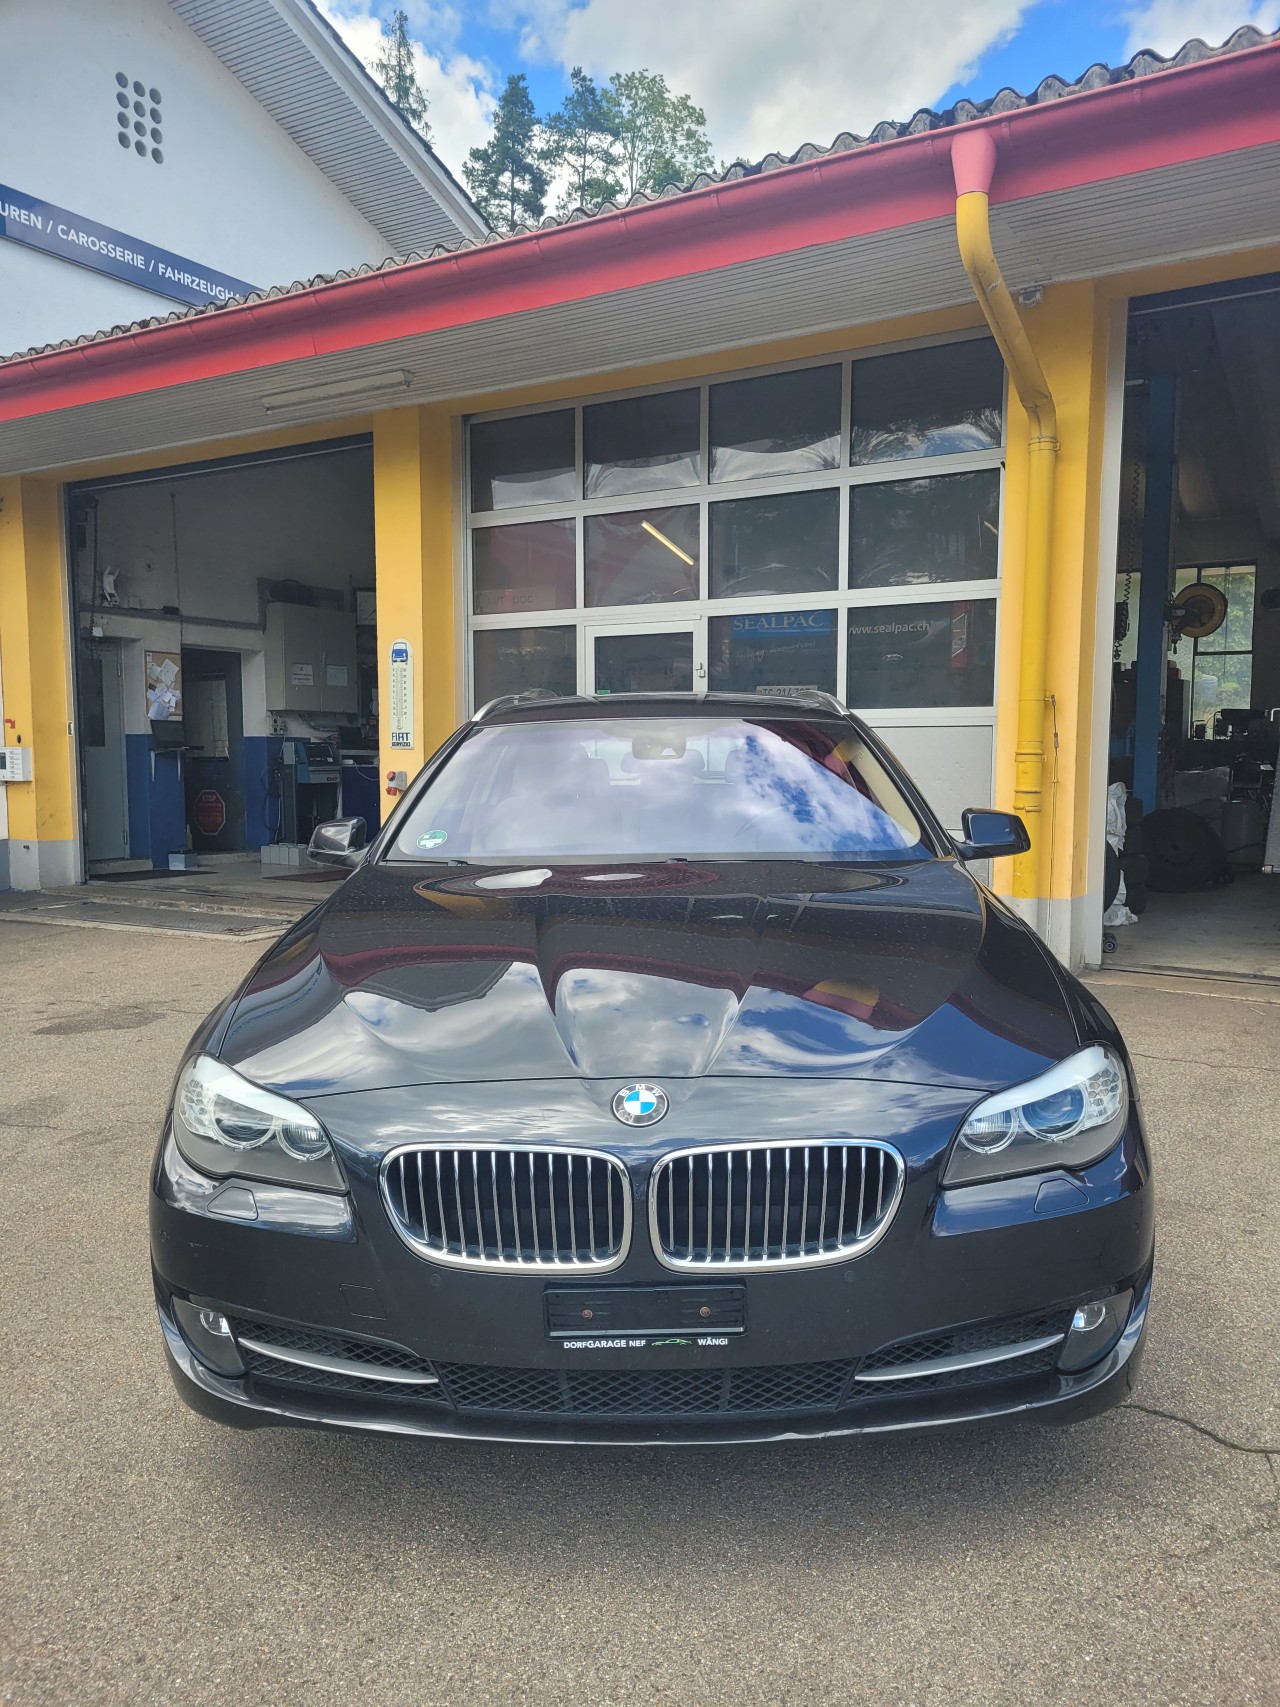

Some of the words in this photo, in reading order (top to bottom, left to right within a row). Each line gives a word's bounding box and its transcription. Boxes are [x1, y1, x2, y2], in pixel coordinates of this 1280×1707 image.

[57, 224, 146, 270] CAROSSERIE
[733, 612, 824, 631] SEALPAC
[848, 621, 930, 635] ww.sealpac.ch
[392, 732, 411, 742] FIAT
[618, 1084, 664, 1098] BMW
[563, 1340, 627, 1349] DORFGARAGE
[629, 1340, 646, 1348] NEF
[697, 1337, 728, 1347] WÄNGI
